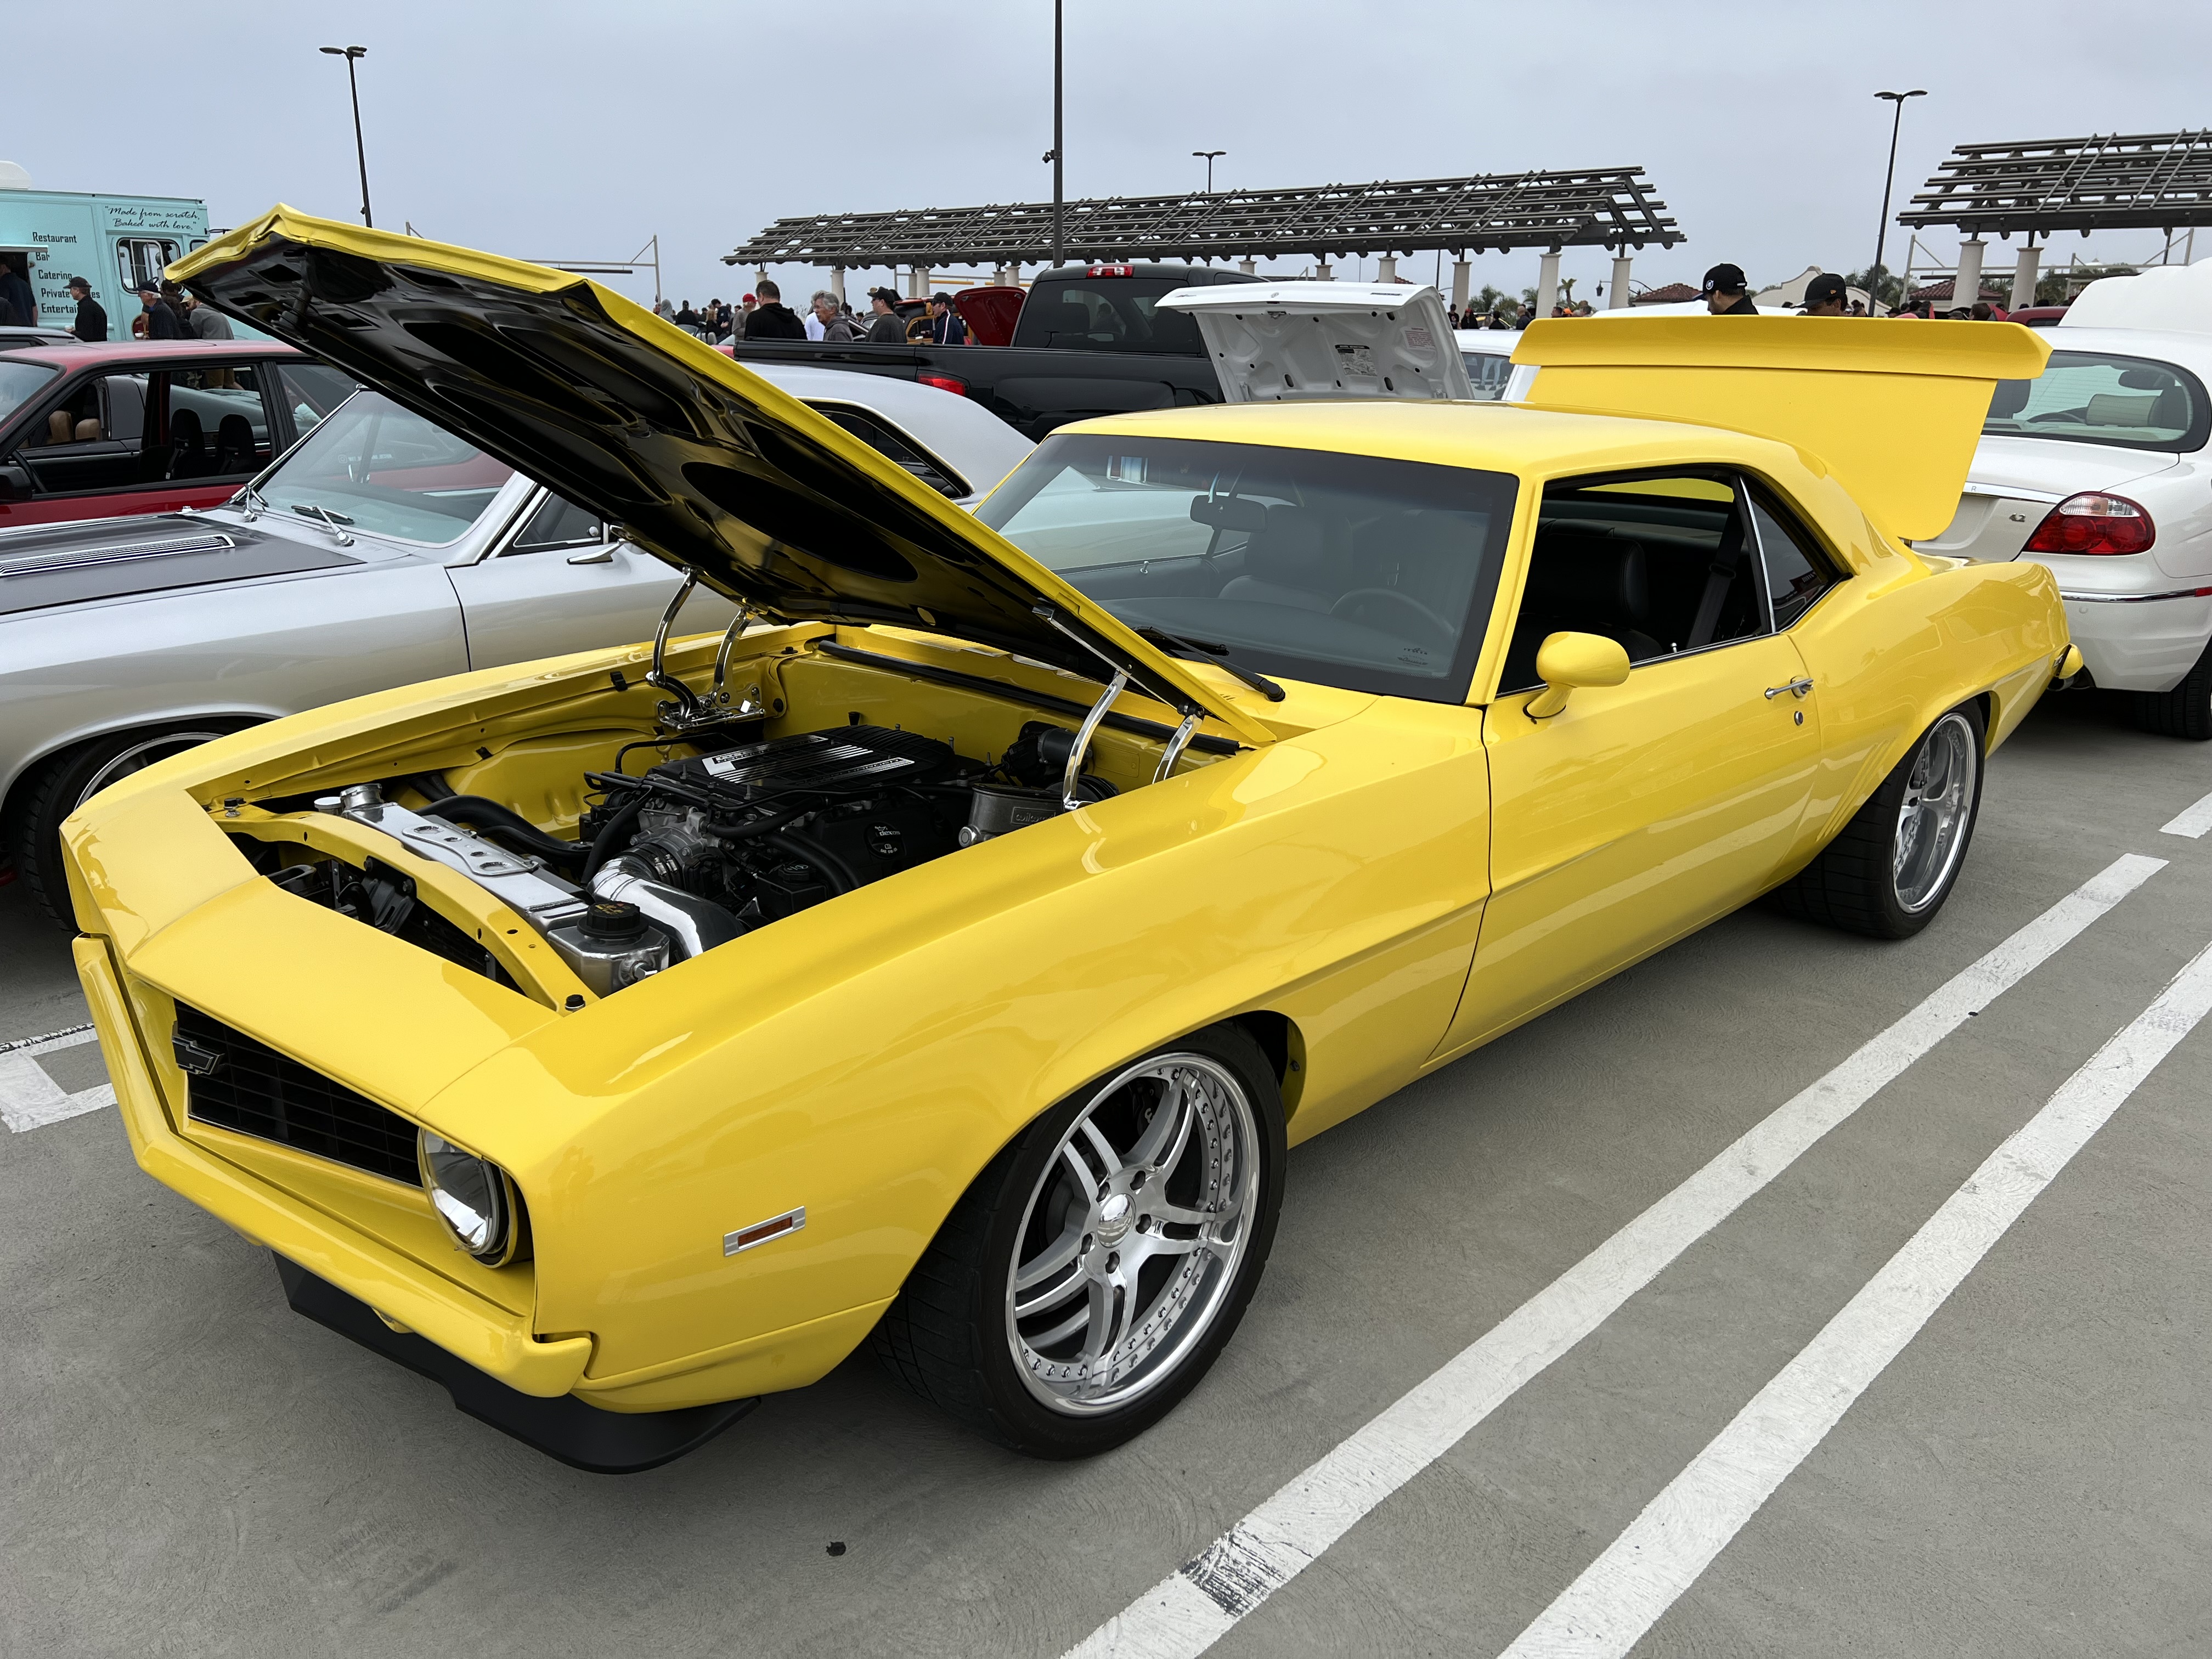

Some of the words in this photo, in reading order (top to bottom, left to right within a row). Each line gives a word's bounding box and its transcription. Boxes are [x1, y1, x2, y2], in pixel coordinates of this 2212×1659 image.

[139, 207, 161, 220] from
[166, 211, 200, 219] scratch,
[112, 218, 144, 227] Baked
[149, 220, 170, 228] with
[32, 232, 77, 244] Restaurant
[36, 252, 50, 261] Bar
[38, 269, 72, 281] Catering
[41, 287, 70, 298] Private
[41, 303, 77, 314] Entertai
